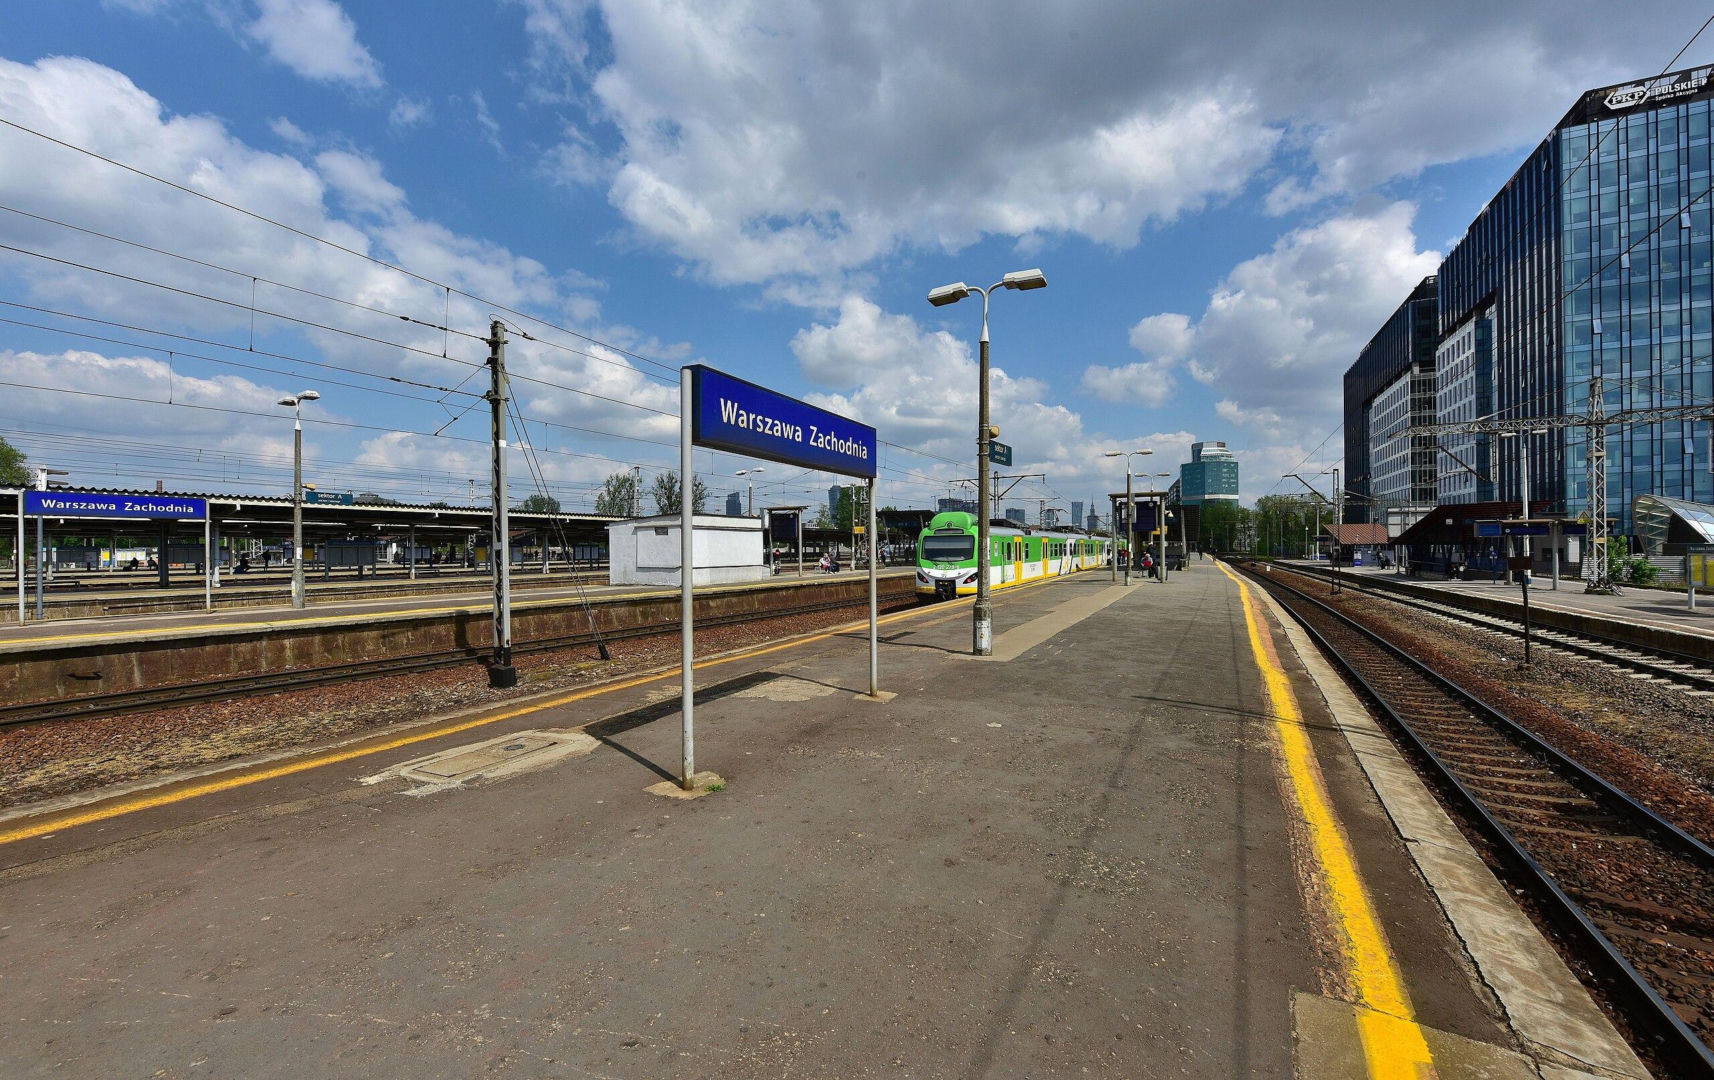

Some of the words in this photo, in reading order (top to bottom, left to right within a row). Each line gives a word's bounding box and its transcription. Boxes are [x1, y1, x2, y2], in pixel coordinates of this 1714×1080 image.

[1611, 91, 1644, 105] PKP
[1655, 79, 1698, 95] POLSKIE
[719, 397, 802, 443] Warszawa
[808, 425, 868, 460] Zachodnia
[41, 498, 116, 511] Warszawa
[124, 502, 194, 513] Zachodnia
